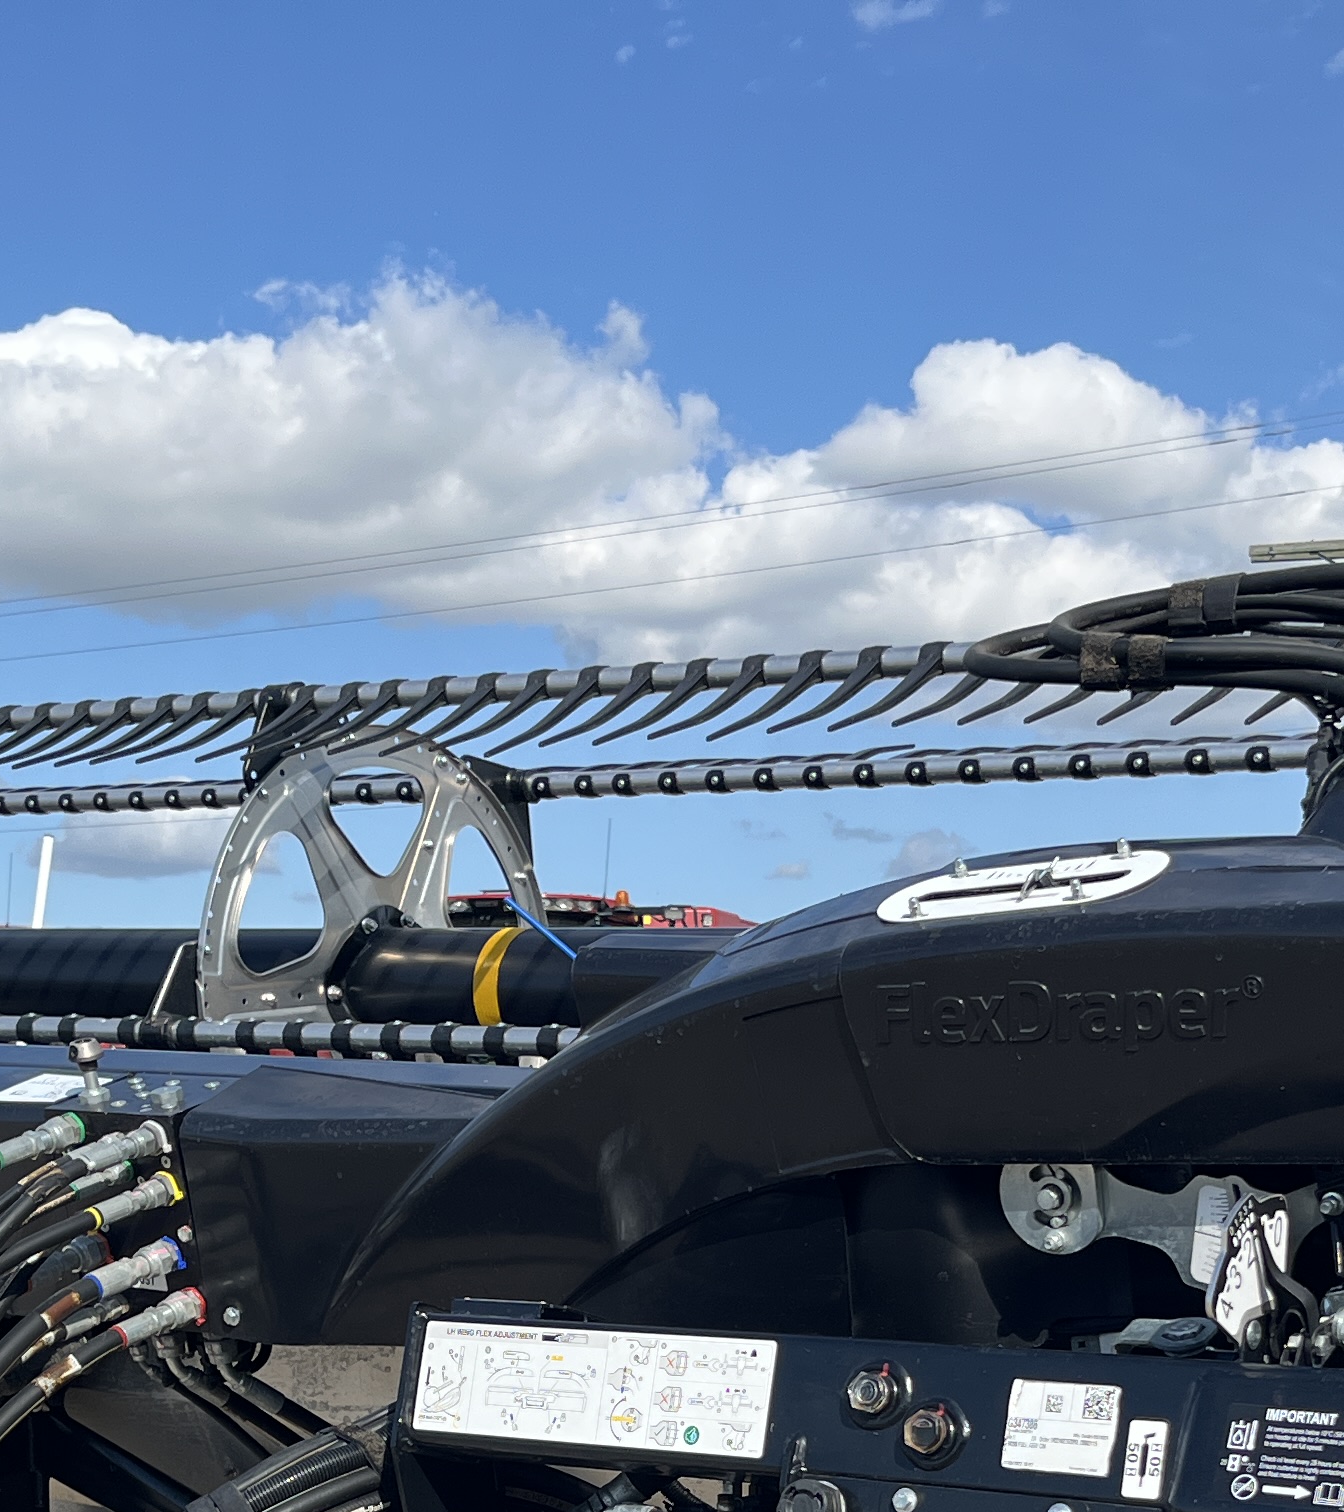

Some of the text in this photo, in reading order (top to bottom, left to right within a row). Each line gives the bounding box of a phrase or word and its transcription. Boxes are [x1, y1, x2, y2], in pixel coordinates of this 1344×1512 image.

[475, 1329, 493, 1338] FLEX
[493, 1330, 538, 1340] ADJUSTMENT
[1265, 1408, 1339, 1426] IMPORTANT
[1127, 1442, 1139, 1463] 50
[1148, 1456, 1161, 1478] 50
